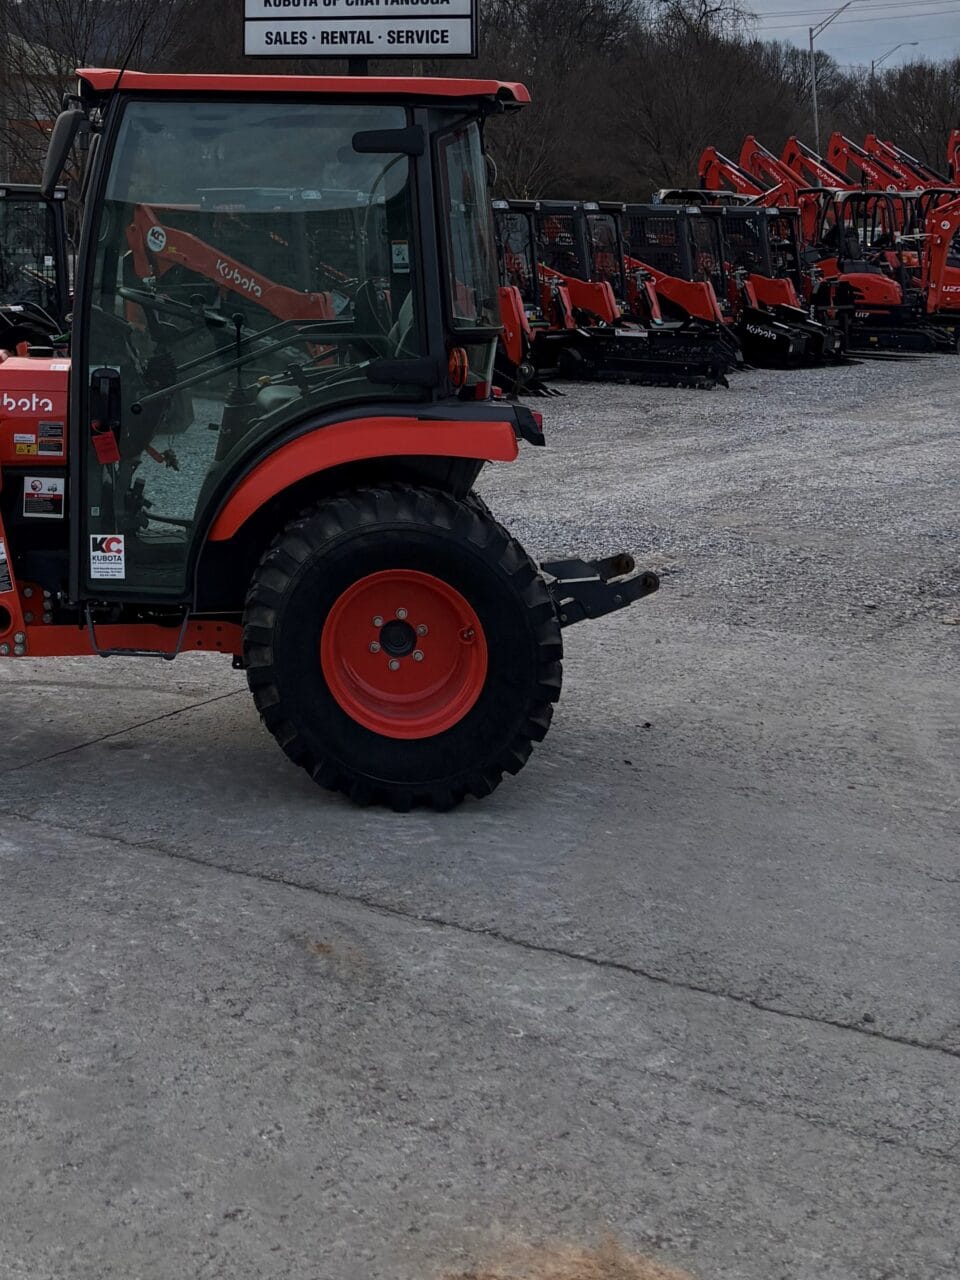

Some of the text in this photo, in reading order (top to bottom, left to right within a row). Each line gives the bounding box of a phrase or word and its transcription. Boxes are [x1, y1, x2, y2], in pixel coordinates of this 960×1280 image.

[265, 29, 449, 46] SALES RENTAL SERVICE
[216, 259, 262, 298] Kubota
[746, 323, 777, 341] Kubota
[92, 536, 123, 554] KC
